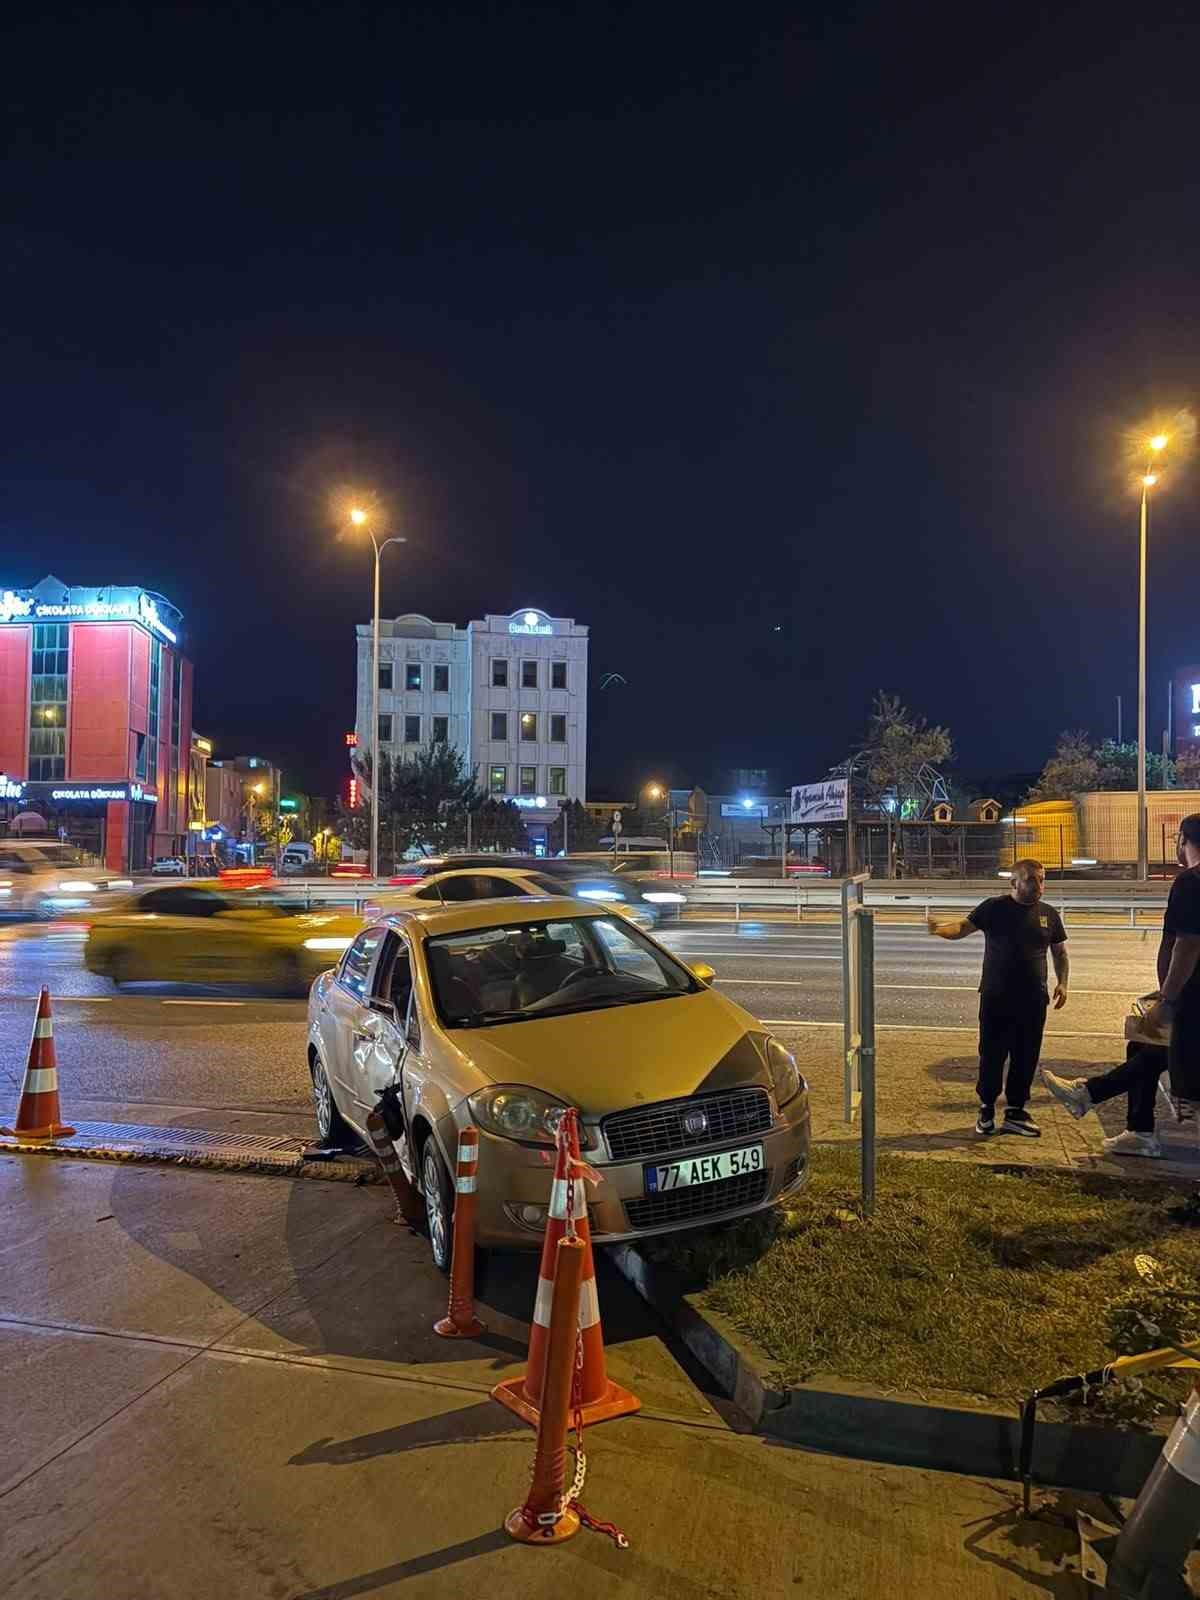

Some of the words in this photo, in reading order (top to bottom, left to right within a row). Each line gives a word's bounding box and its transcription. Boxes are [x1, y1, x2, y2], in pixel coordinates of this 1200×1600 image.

[659, 1166, 681, 1190] 77
[690, 1157, 722, 1184] AEK
[730, 1149, 760, 1175] 549
